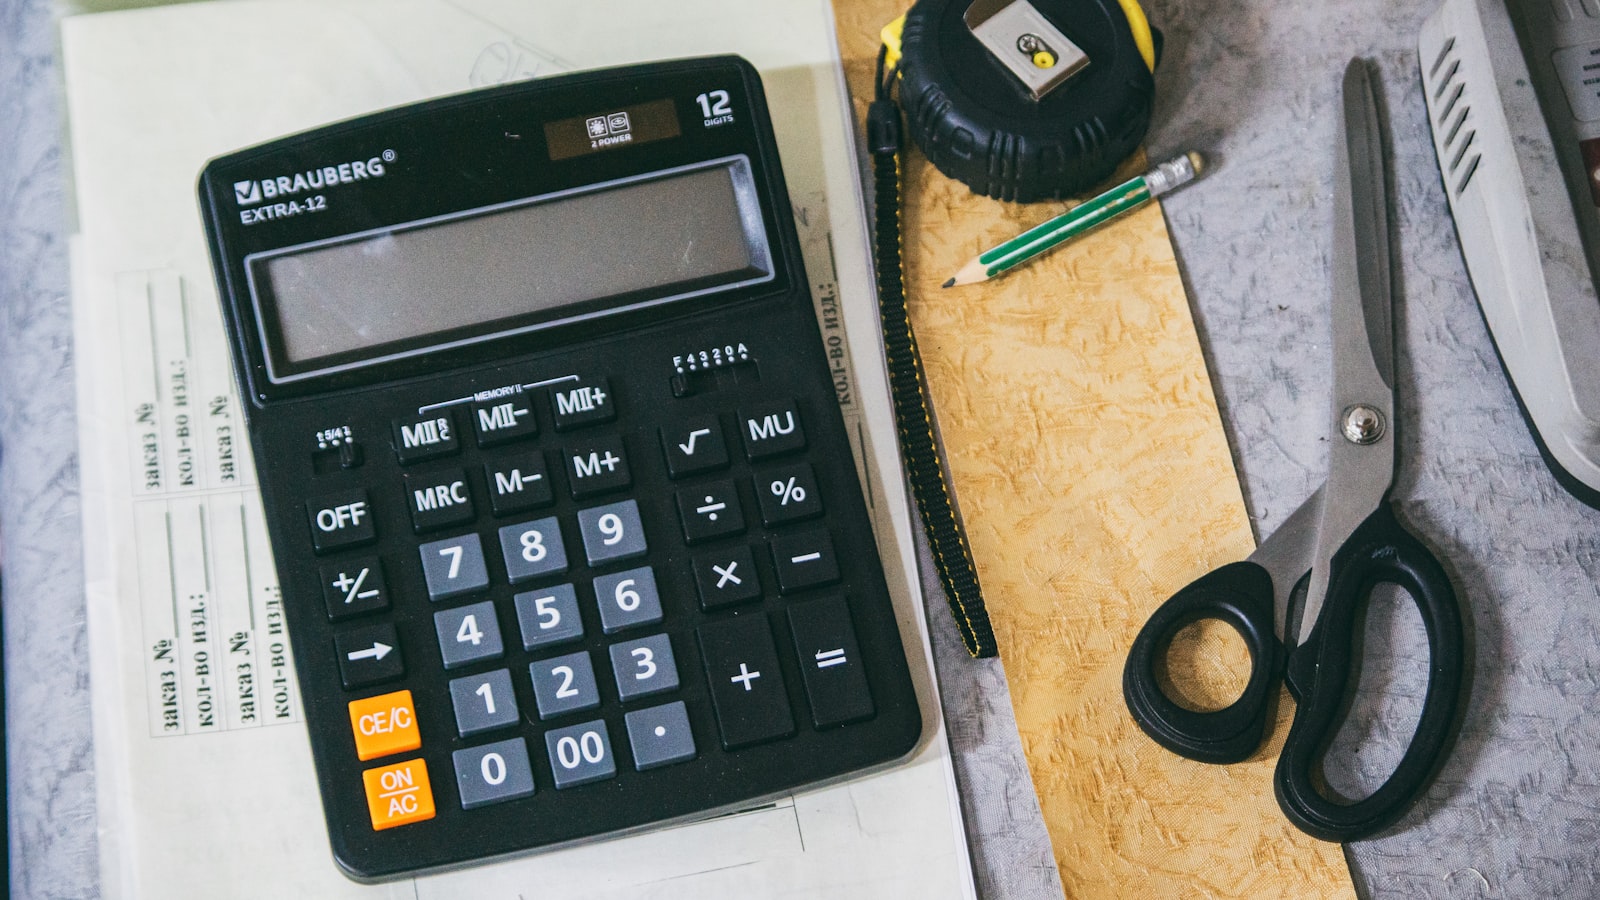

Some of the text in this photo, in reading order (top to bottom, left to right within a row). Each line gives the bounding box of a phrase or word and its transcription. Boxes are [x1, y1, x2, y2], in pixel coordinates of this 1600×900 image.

[696, 89, 733, 118] 12
[704, 114, 734, 127] DIGITS
[591, 133, 632, 148] 2 POWER
[240, 195, 327, 225] EXTRA-12
[474, 385, 514, 402] MEMORY
[748, 411, 795, 441] MU
[572, 451, 620, 478] M+
[414, 481, 467, 512] MRC
[770, 476, 806, 506] %
[316, 501, 366, 532] OFF
[598, 513, 624, 546] 9
[519, 530, 547, 562] 8
[438, 546, 463, 579] 7
[614, 579, 641, 612] 6
[534, 595, 561, 630] 5
[456, 614, 484, 646] 4
[631, 647, 657, 680] 3
[236, 662, 256, 724] заказ
[551, 665, 579, 699] 2
[160, 670, 179, 732] заказ
[475, 682, 496, 714] 1
[358, 706, 412, 736] CE/C
[556, 730, 605, 769] 00
[380, 767, 413, 792] ON
[480, 752, 507, 785] 0
[387, 793, 418, 818] AC
